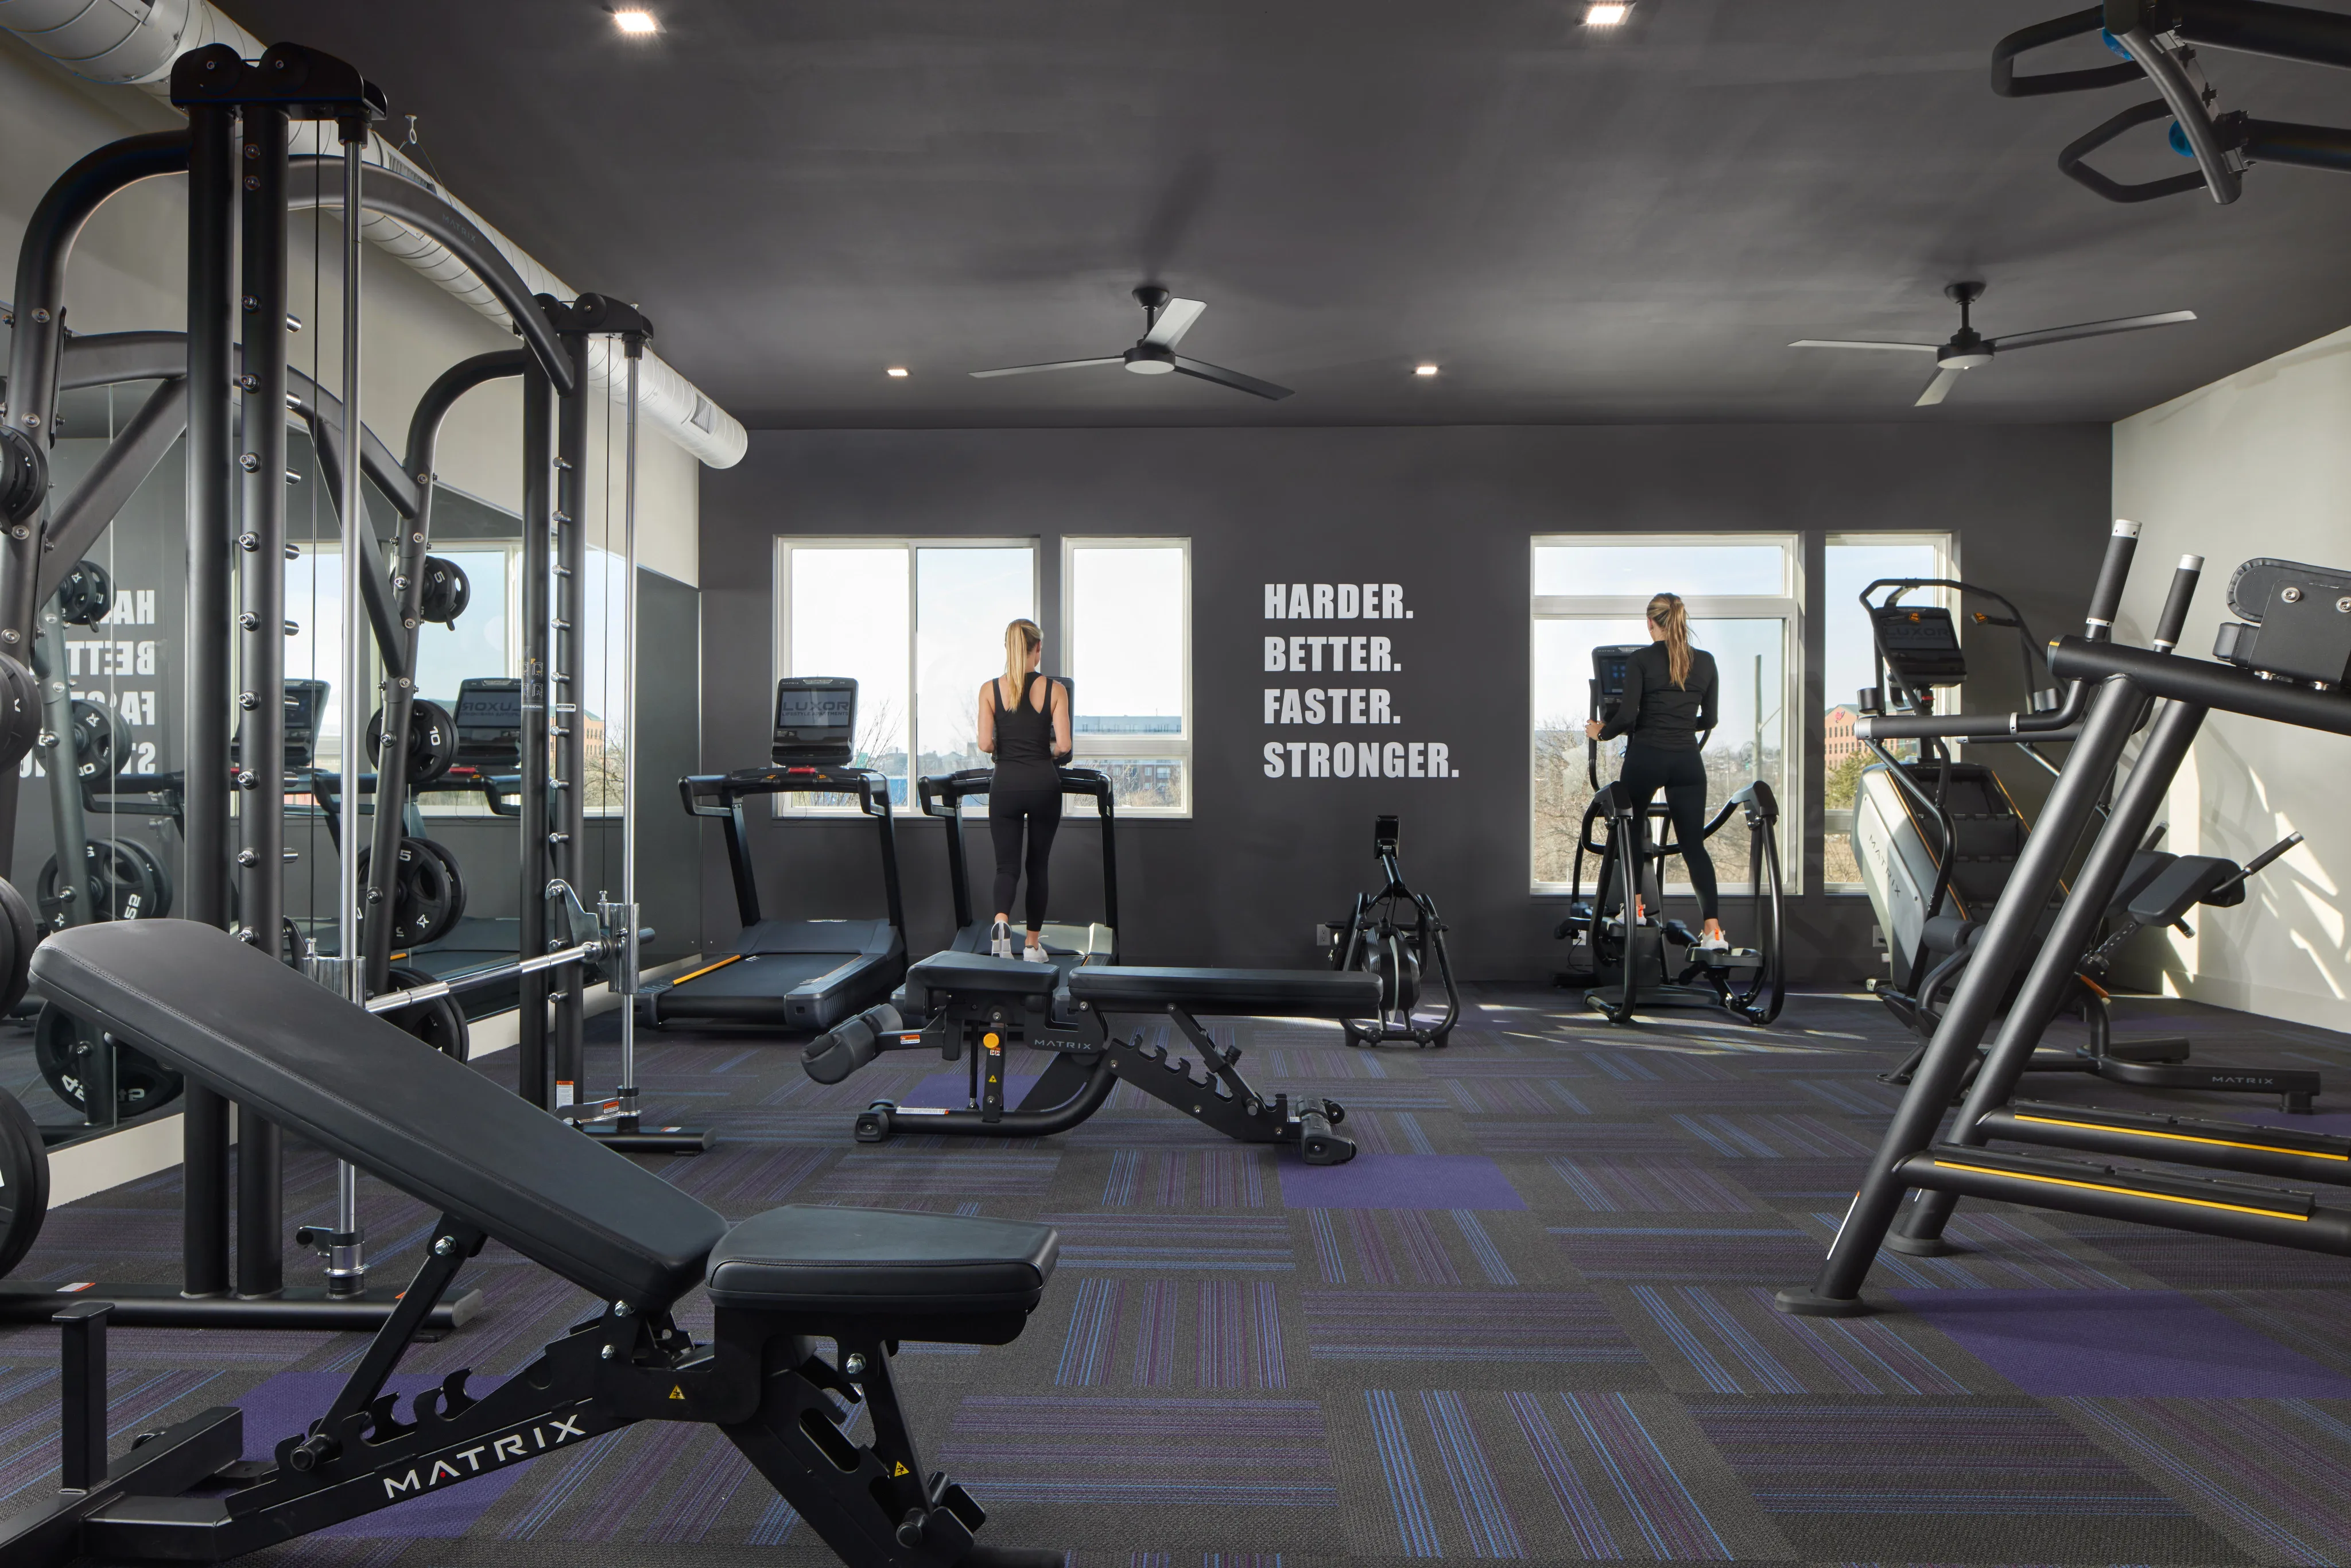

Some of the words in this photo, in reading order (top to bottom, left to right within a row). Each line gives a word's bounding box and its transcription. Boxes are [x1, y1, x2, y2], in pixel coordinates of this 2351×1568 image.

[443, 213, 476, 243] MATRIX
[1264, 584, 1414, 619] HARDER.
[1264, 636, 1402, 672] BETTER.
[783, 701, 849, 711] LUXOR
[1264, 688, 1401, 724] FASTER.
[429, 726, 441, 746] 10
[1263, 742, 1460, 778] STRONGER.
[1869, 834, 1901, 899] MATRIX
[1034, 1039, 1092, 1050] MATRIX
[2212, 1076, 2274, 1084] MATRIX
[383, 1414, 587, 1499] MATRIX
